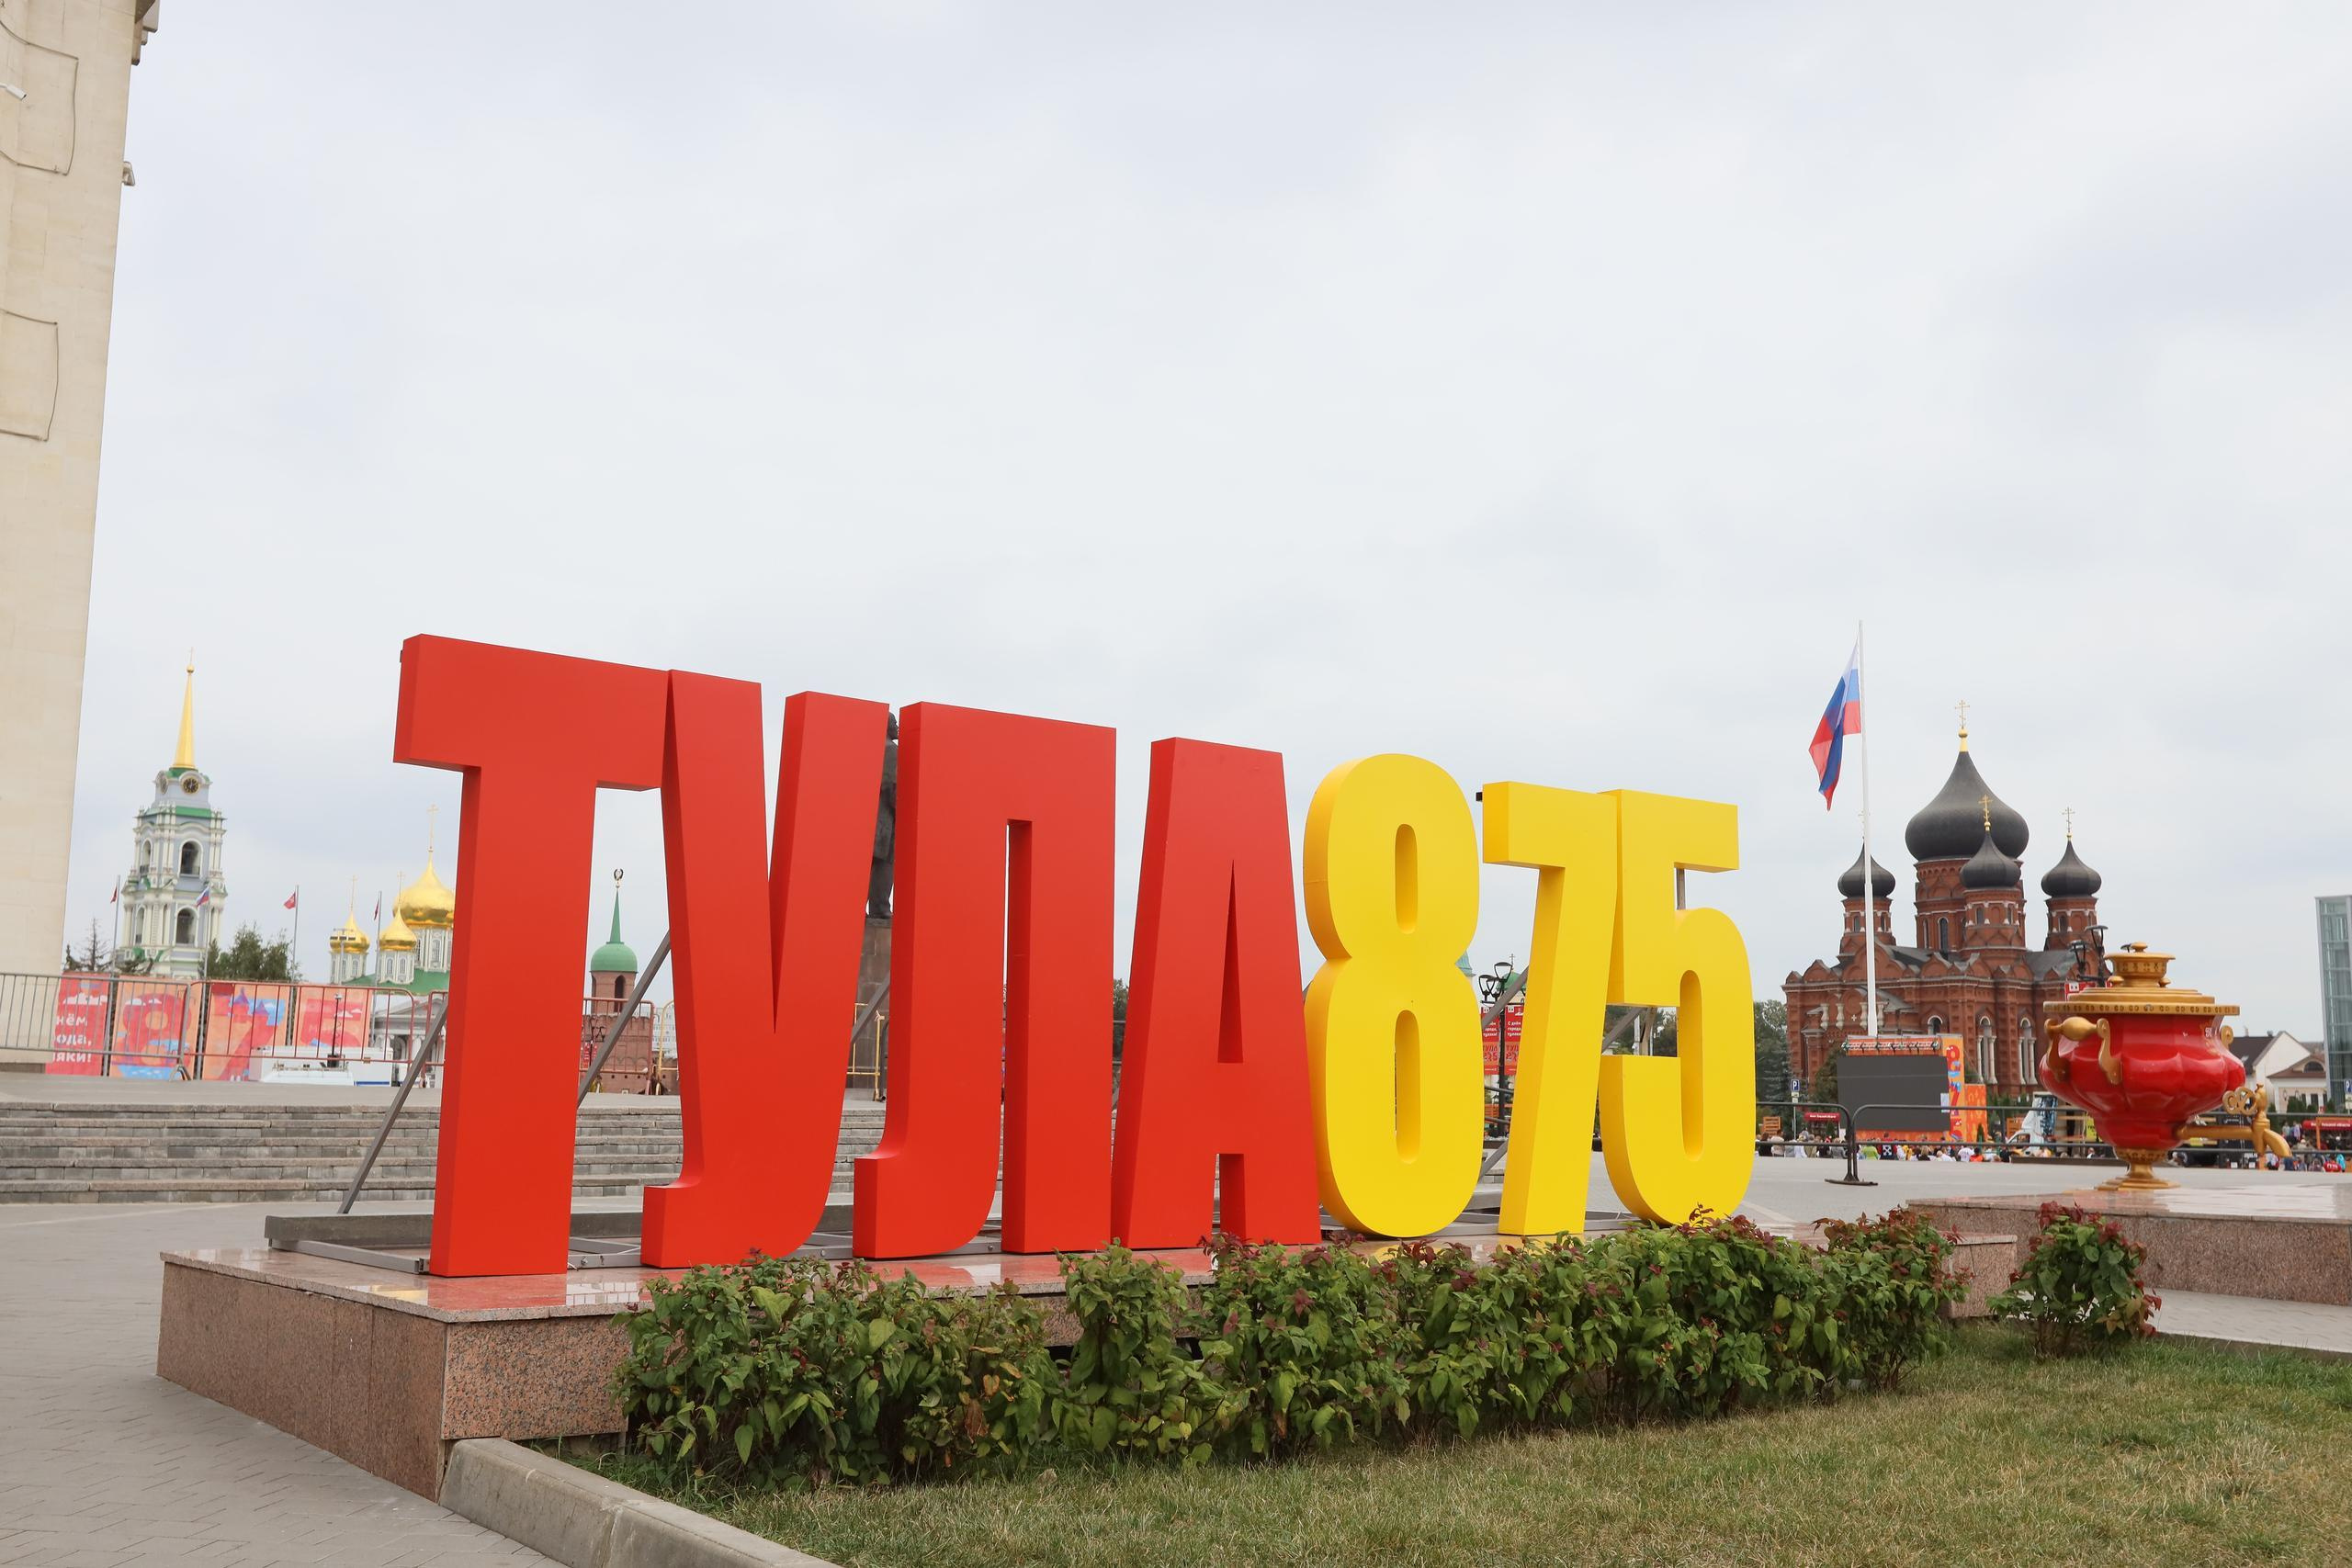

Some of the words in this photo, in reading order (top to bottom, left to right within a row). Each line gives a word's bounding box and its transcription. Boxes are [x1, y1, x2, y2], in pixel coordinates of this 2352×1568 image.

[393, 634, 1322, 1278] ТУЛА
[1303, 754, 1757, 1237] 875
[56, 1013, 88, 1027] нём
[56, 1033, 92, 1046] ода,
[52, 1051, 92, 1063] яки!
